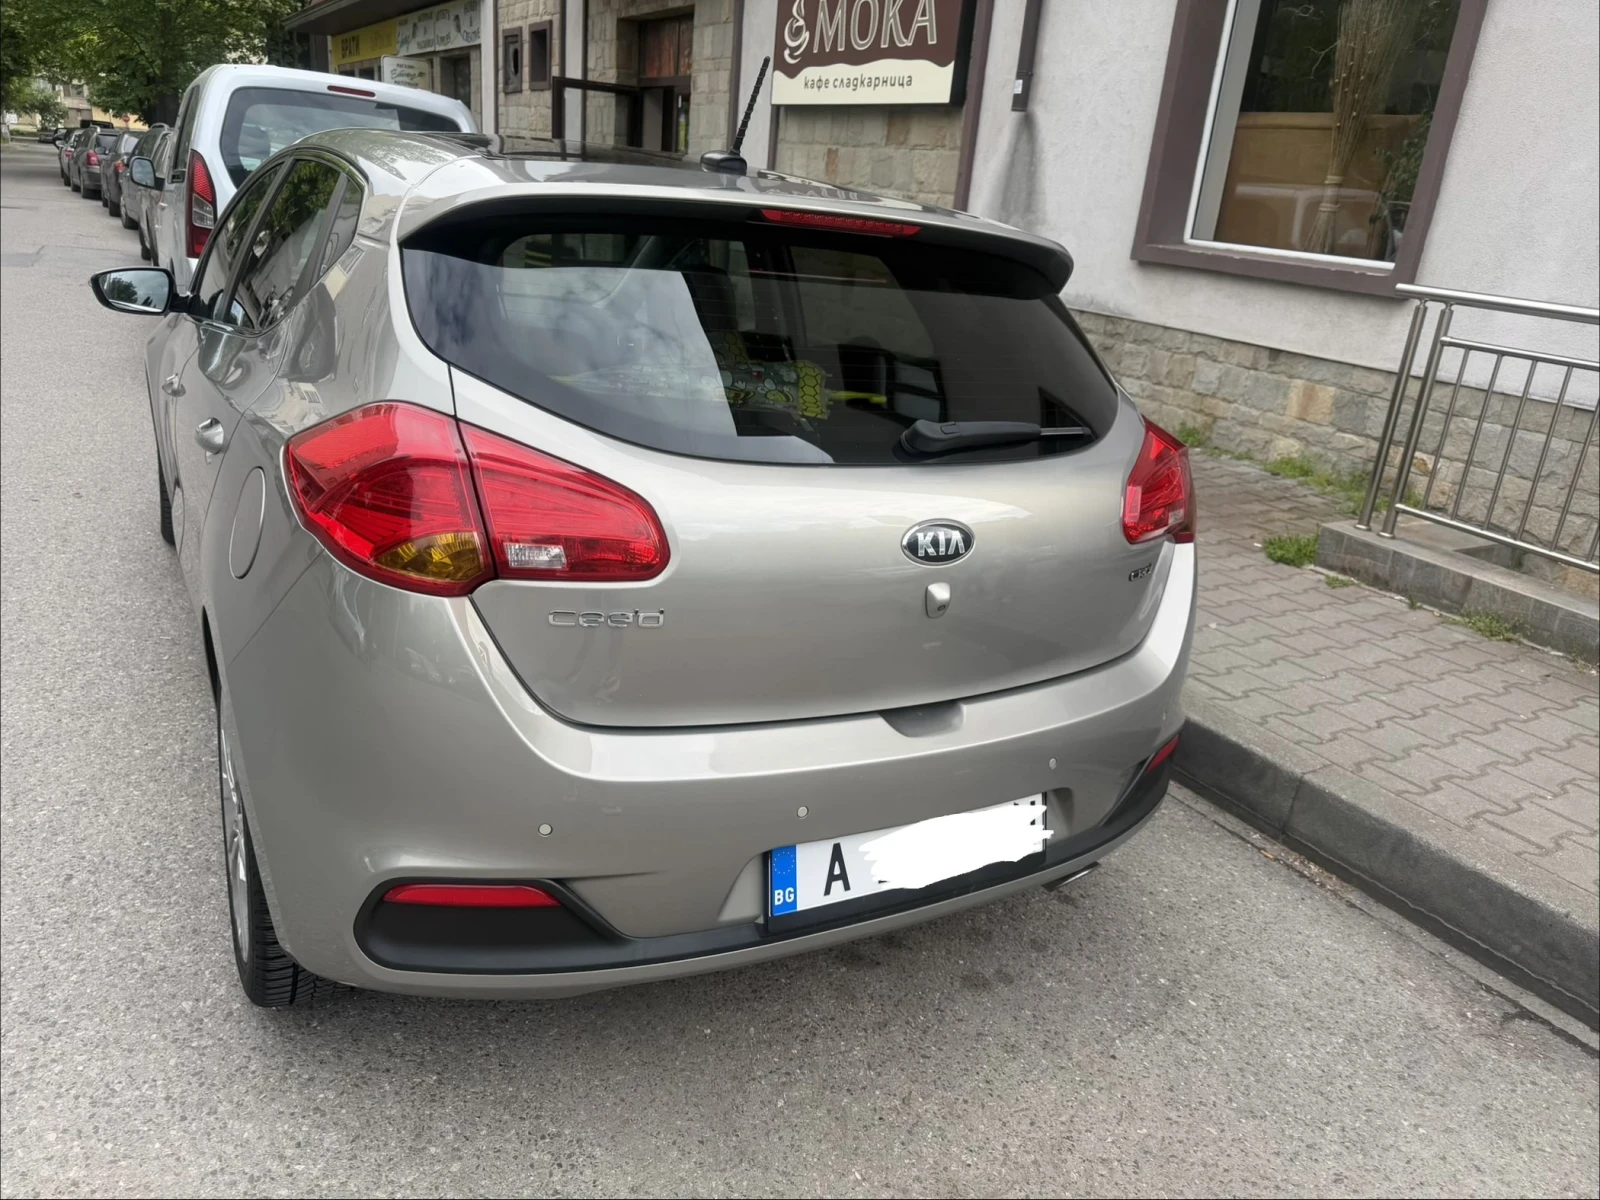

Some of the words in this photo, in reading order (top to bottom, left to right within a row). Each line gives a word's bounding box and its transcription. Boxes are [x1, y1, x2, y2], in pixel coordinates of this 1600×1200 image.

[804, 75, 830, 91] кафе
[832, 73, 913, 92] сладкарница
[917, 530, 966, 557] KIA
[774, 887, 795, 905] BG
